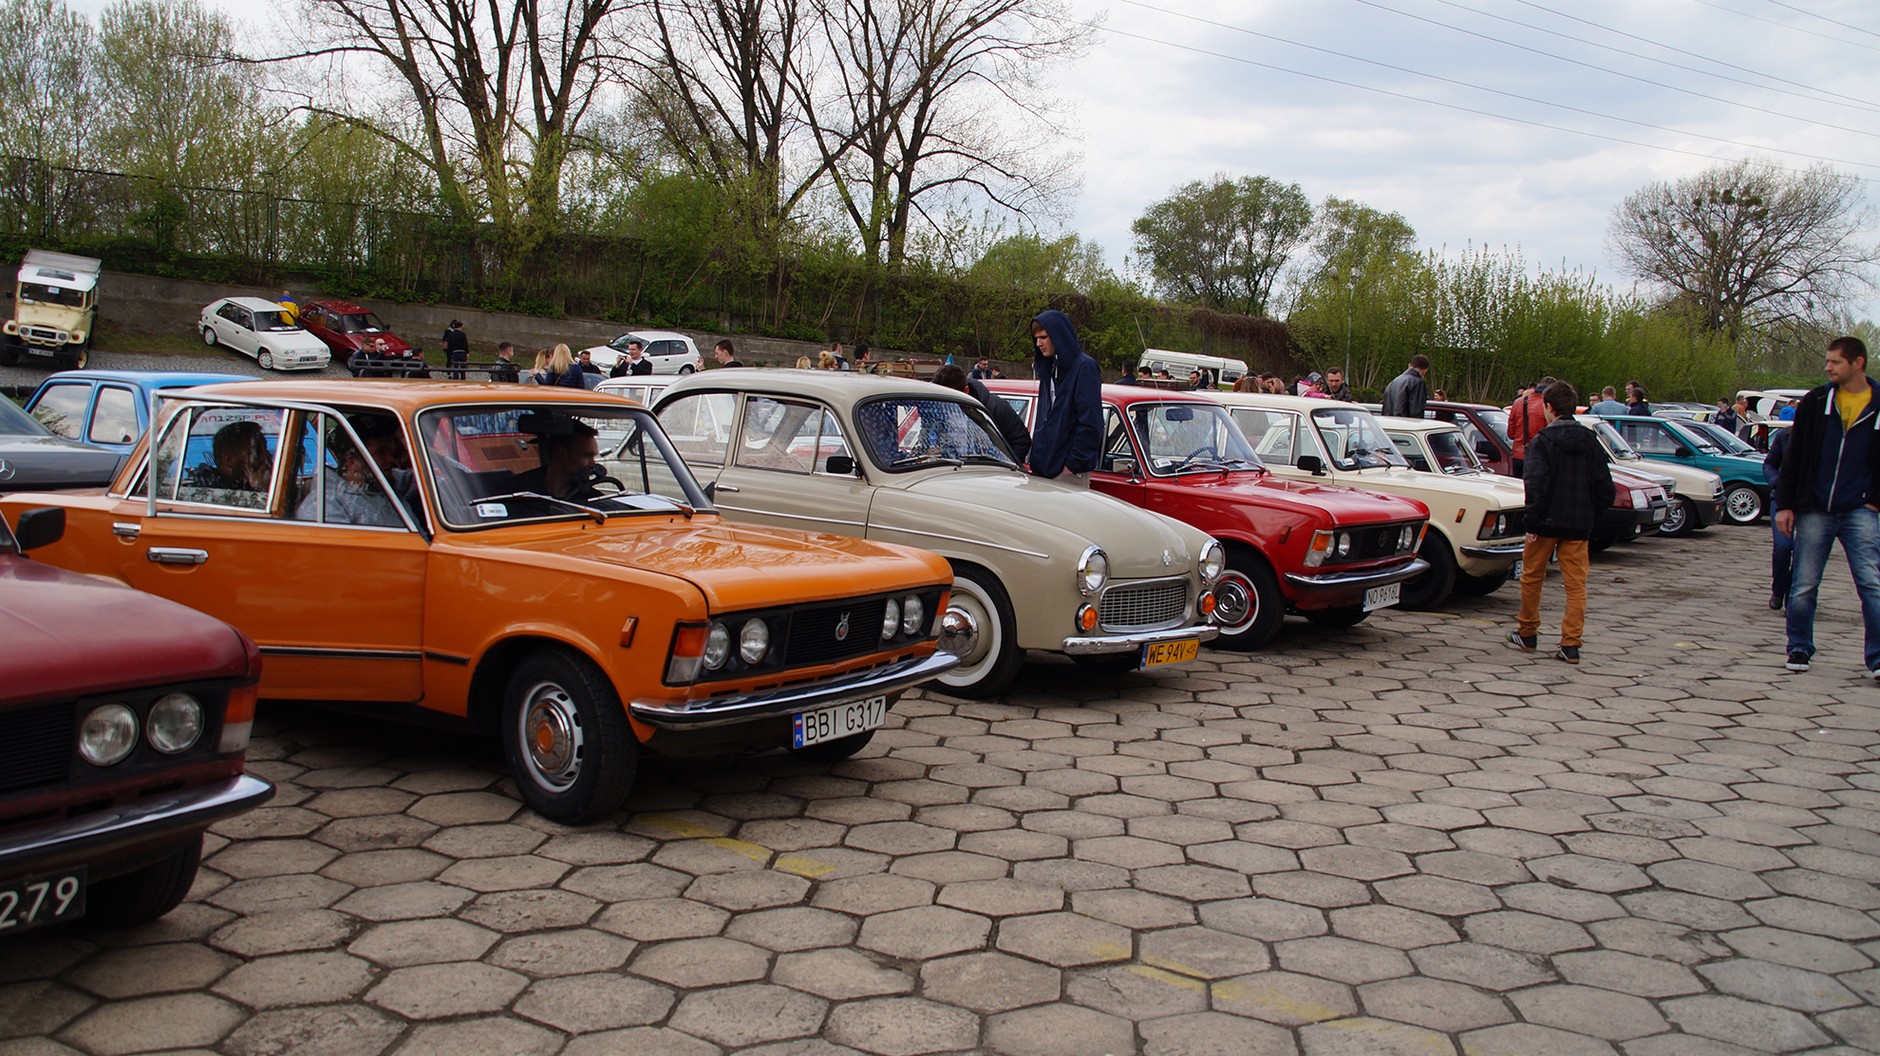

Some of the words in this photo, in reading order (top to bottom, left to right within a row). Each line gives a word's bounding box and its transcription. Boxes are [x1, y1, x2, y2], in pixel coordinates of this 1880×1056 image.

[1149, 645, 1165, 664] WE
[1166, 642, 1187, 662] 94V
[806, 710, 837, 741] BBI
[846, 699, 883, 731] G317
